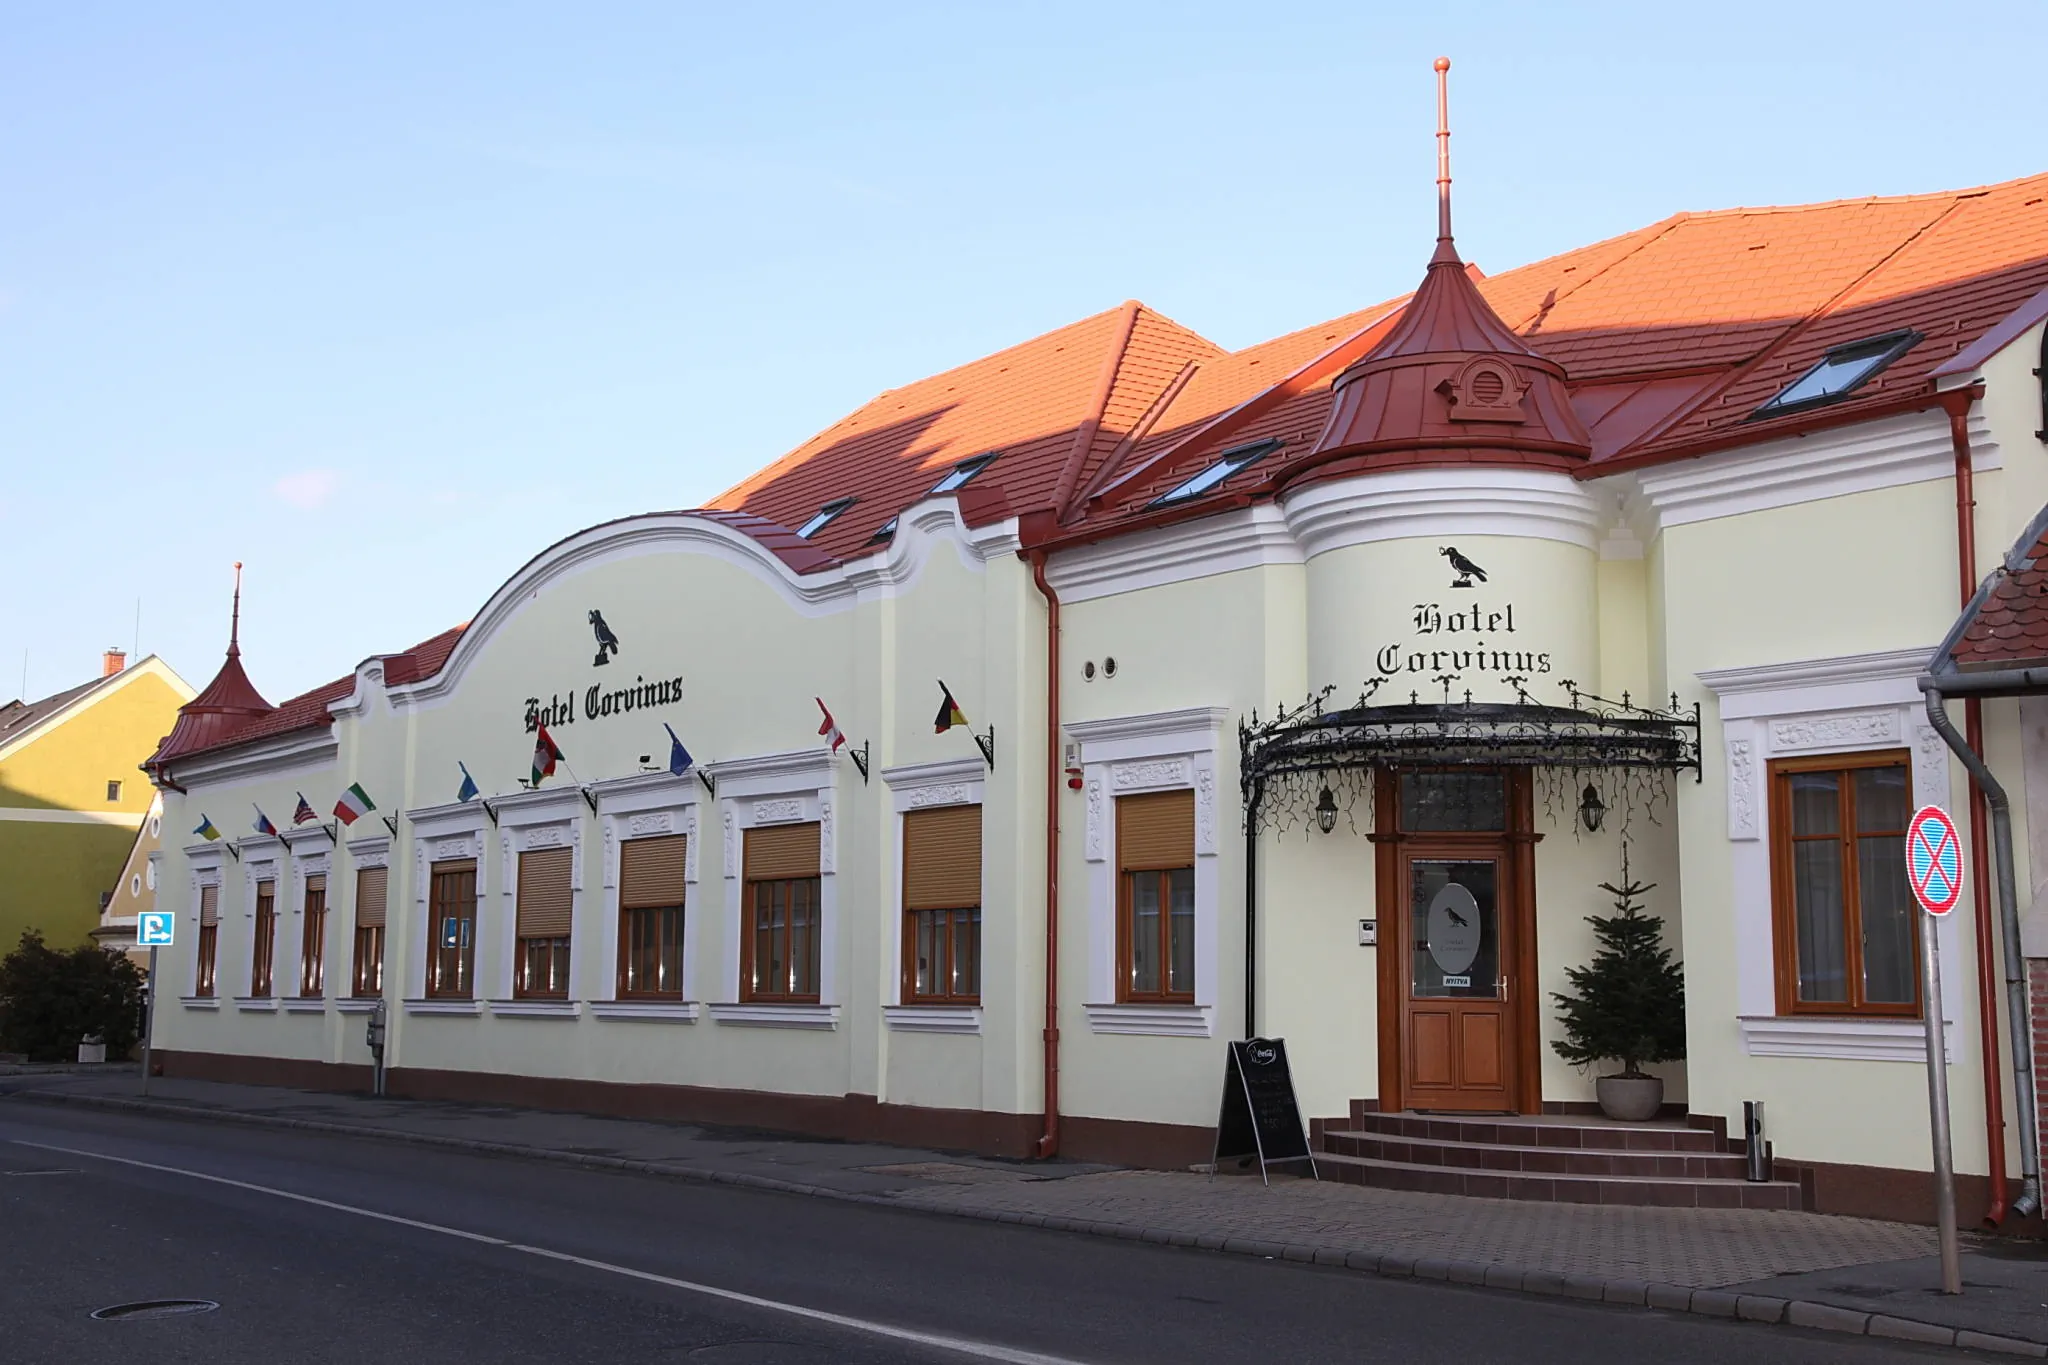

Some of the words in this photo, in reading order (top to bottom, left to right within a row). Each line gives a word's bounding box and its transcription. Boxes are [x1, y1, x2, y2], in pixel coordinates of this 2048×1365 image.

[1412, 602, 1516, 635] Hotel
[1376, 641, 1551, 675] Corvinus
[524, 690, 575, 734] Hotel
[585, 675, 683, 720] Corvinus
[144, 915, 164, 942] P
